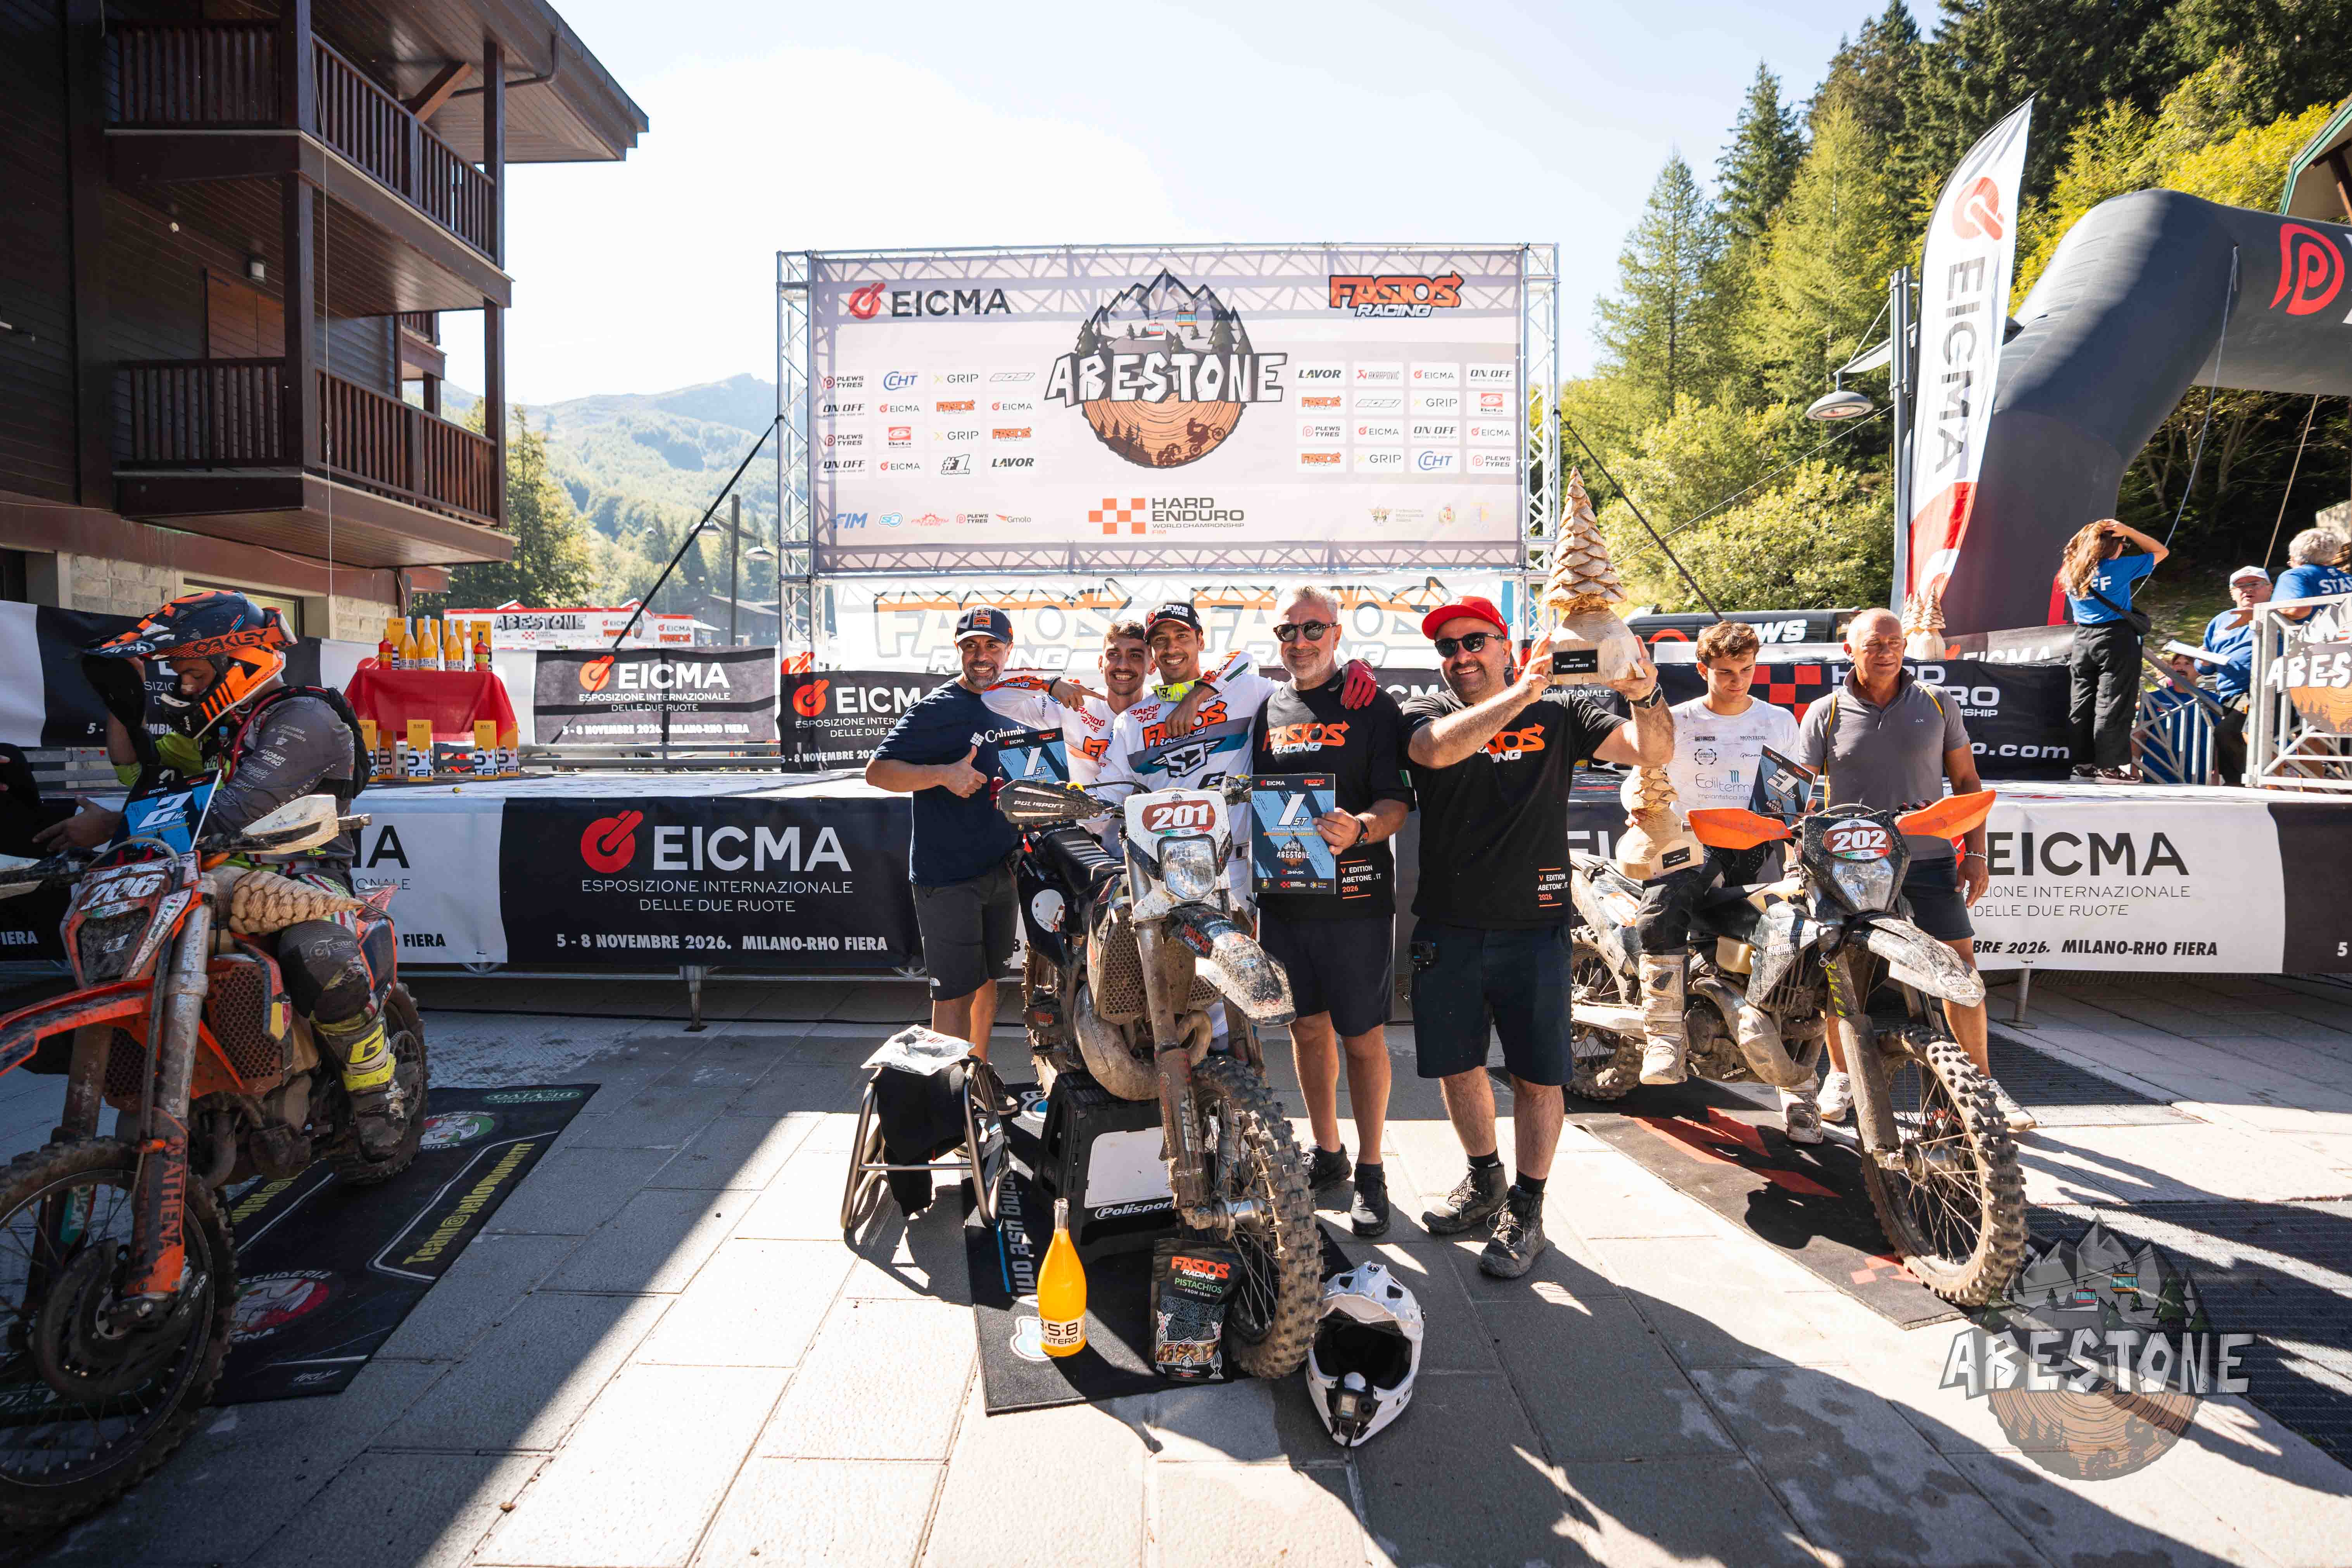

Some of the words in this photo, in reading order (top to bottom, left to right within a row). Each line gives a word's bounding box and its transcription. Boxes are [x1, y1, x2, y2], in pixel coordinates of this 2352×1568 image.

[892, 288, 1012, 317] EICMA
[1355, 304, 1432, 317] RACING
[1935, 256, 1986, 473] EICMA
[947, 374, 979, 383] GRIP
[1045, 351, 1287, 408] ABESTONE
[1299, 369, 1342, 379] LAVOR
[823, 404, 839, 413] ON
[844, 403, 865, 411] OFF
[890, 404, 920, 413] EICMA
[1426, 398, 1457, 407] GRIP
[947, 431, 979, 440] GRIP
[1414, 426, 1431, 434] ON
[1434, 427, 1457, 435] OFF
[843, 460, 865, 468] OFF
[991, 458, 1034, 468] LAVOR
[1369, 454, 1401, 463] GRIP
[890, 462, 920, 470] EICMA
[1152, 498, 1214, 509] HARD
[834, 513, 868, 528] FIM
[1152, 510, 1244, 522] ENDURO
[1154, 604, 1188, 615] PLEWS
[494, 615, 586, 631] ABESTONE
[194, 630, 268, 654] OAKLEY
[618, 662, 731, 689] EICMA
[579, 693, 646, 702] ESPOSIZIONE
[648, 692, 730, 701] INTERNAZIONALE
[611, 704, 643, 712] DELLE
[666, 703, 698, 711] RUOTE
[575, 725, 583, 734] 8
[585, 725, 635, 734] NOVEMBRE
[636, 725, 663, 734] 2026.
[669, 724, 723, 734] MILANO-RHO
[725, 724, 749, 734] FIERA
[795, 717, 865, 729] ESPOSIZIONE
[830, 728, 863, 737] DELLE
[1156, 727, 1207, 746] RACING
[1271, 741, 1322, 755] RACING
[794, 754, 800, 763] 8
[803, 751, 853, 762] NOVEMBRE
[1770, 754, 1783, 763] EICMA
[1014, 800, 1065, 808] POLISPORT
[1151, 804, 1209, 830] 201
[1832, 830, 1887, 852] 202
[653, 825, 852, 872] EICMA
[1987, 832, 2190, 876] EICMA
[1349, 865, 1373, 873] EDITION
[582, 879, 699, 893] ESPOSIZIONE
[703, 879, 853, 894] INTERNAZIONALE
[2034, 886, 2191, 899] INTERNAZIONALE
[639, 899, 694, 912] DELLE
[698, 899, 734, 912] DUE
[738, 899, 796, 912] RUOTE
[1974, 904, 2021, 918] DELLE
[2027, 904, 2064, 917] DUE
[2069, 904, 2129, 917] RUOTE
[0, 931, 38, 945] IERA
[402, 933, 446, 948] FIERA
[556, 934, 566, 948] 5
[582, 933, 591, 948] 8
[596, 934, 680, 949] NOVEMBRE
[684, 934, 732, 950] 2026.
[742, 936, 841, 952] MILANO-RHO
[844, 936, 888, 952] FIERA
[2006, 940, 2051, 955] 2026.
[2061, 939, 2167, 956] MILANO-RHO
[2174, 940, 2218, 957] FIERA
[2336, 942, 2348, 957] 5
[238, 1270, 333, 1285] SCUDERIA
[1182, 1269, 1216, 1281] RACING
[1174, 1278, 1223, 1294] PISTACHIOS
